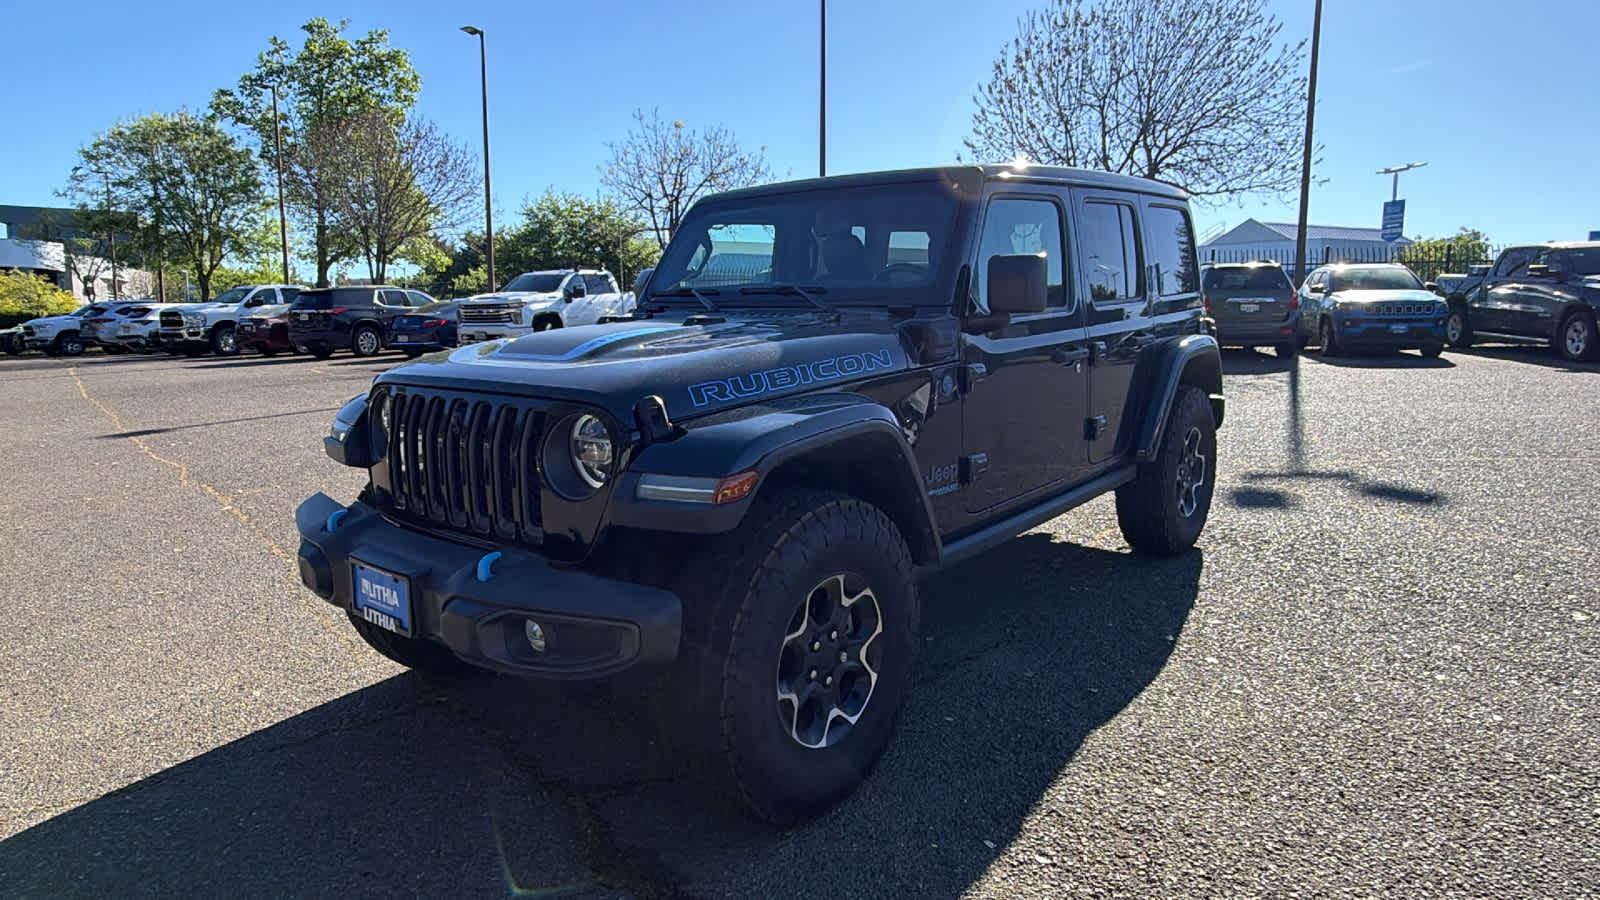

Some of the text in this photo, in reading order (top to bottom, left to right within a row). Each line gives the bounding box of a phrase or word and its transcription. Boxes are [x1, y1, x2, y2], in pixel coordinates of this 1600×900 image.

[688, 349, 894, 407] RUBICON
[925, 464, 959, 482] Jeep
[368, 581, 400, 608] LITHIA
[363, 606, 396, 633] LITHIA
